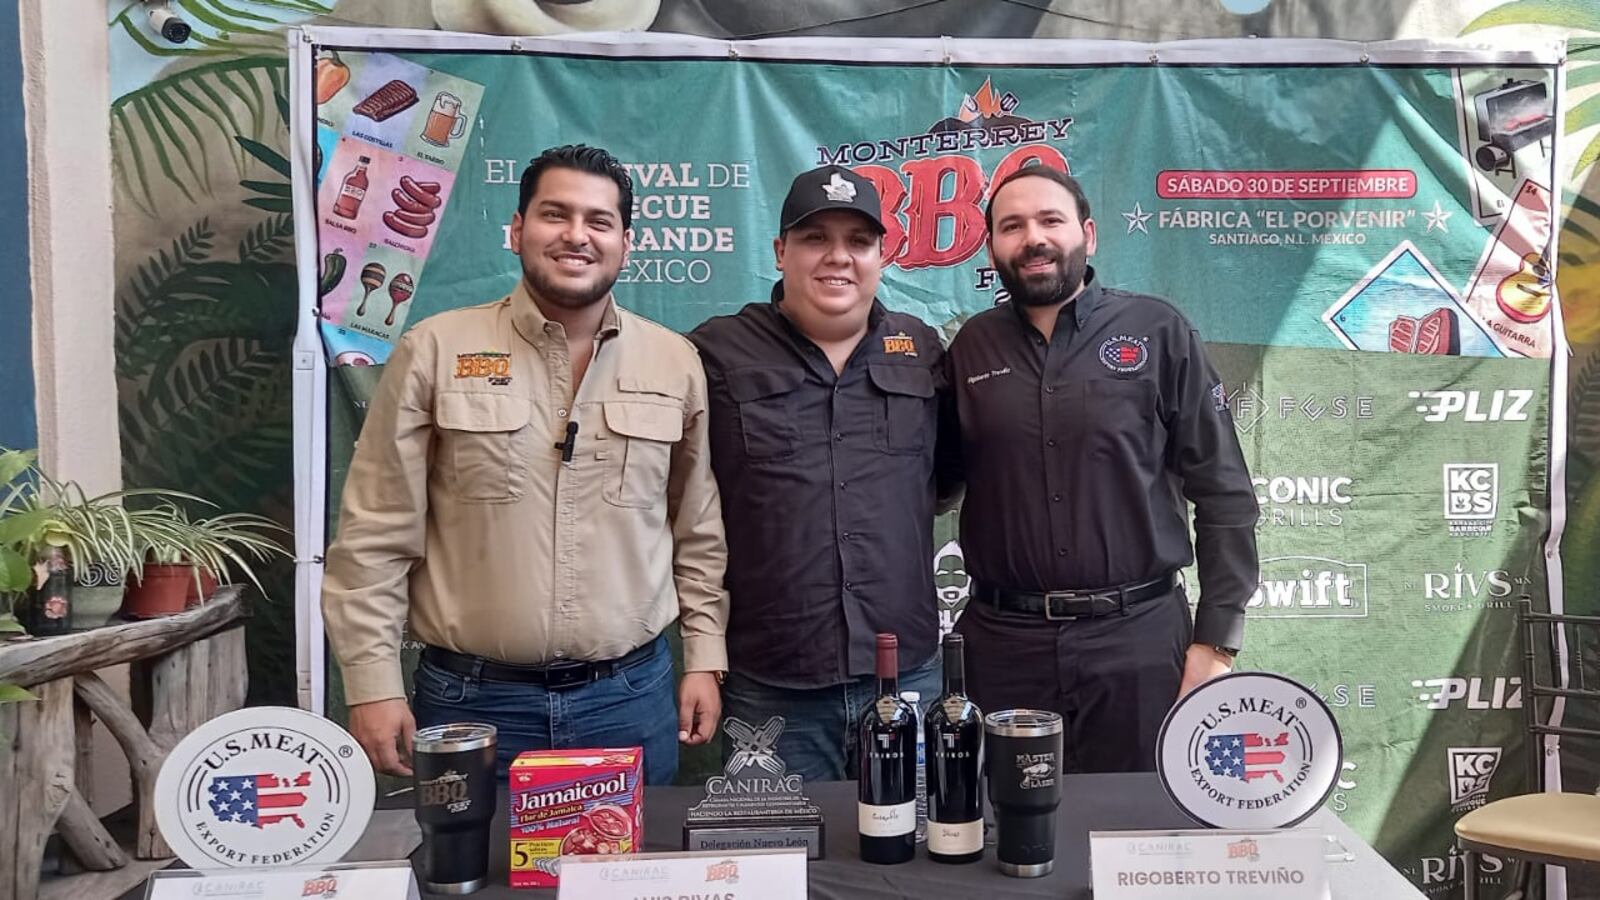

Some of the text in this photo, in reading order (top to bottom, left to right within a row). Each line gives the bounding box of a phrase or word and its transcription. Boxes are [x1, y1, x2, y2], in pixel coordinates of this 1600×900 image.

[816, 118, 1074, 166] MONTERREY
[485, 159, 520, 184] EL
[707, 163, 750, 188] DE
[1167, 176, 1409, 194] SÁBADO 30 DE SEPTIEMBRE
[1158, 207, 1252, 229] FÁBRICA
[1209, 234, 1282, 246] SANTIAGO,
[1493, 323, 1537, 349] GUITARRA
[456, 358, 510, 378] BBQ
[1414, 389, 1534, 422] PLIZ
[1251, 476, 1353, 505] CONIC
[1201, 697, 1299, 730] U.S. MEAT
[204, 733, 324, 771] U.S. MEAT
[421, 781, 469, 806] BBQ
[515, 772, 626, 812] Jamaicool
[709, 778, 801, 795] CANIRAC
[1190, 768, 1235, 807] EXPORT
[1237, 762, 1311, 810] FEDERATION
[195, 812, 336, 865] EXPORT FEDERATION
[754, 838, 783, 848] Nuevo
[786, 837, 808, 847] León
[514, 842, 529, 867] 5
[302, 878, 338, 896] BBQ
[1117, 867, 1304, 886] RIGOBERTO TREVIÑO
